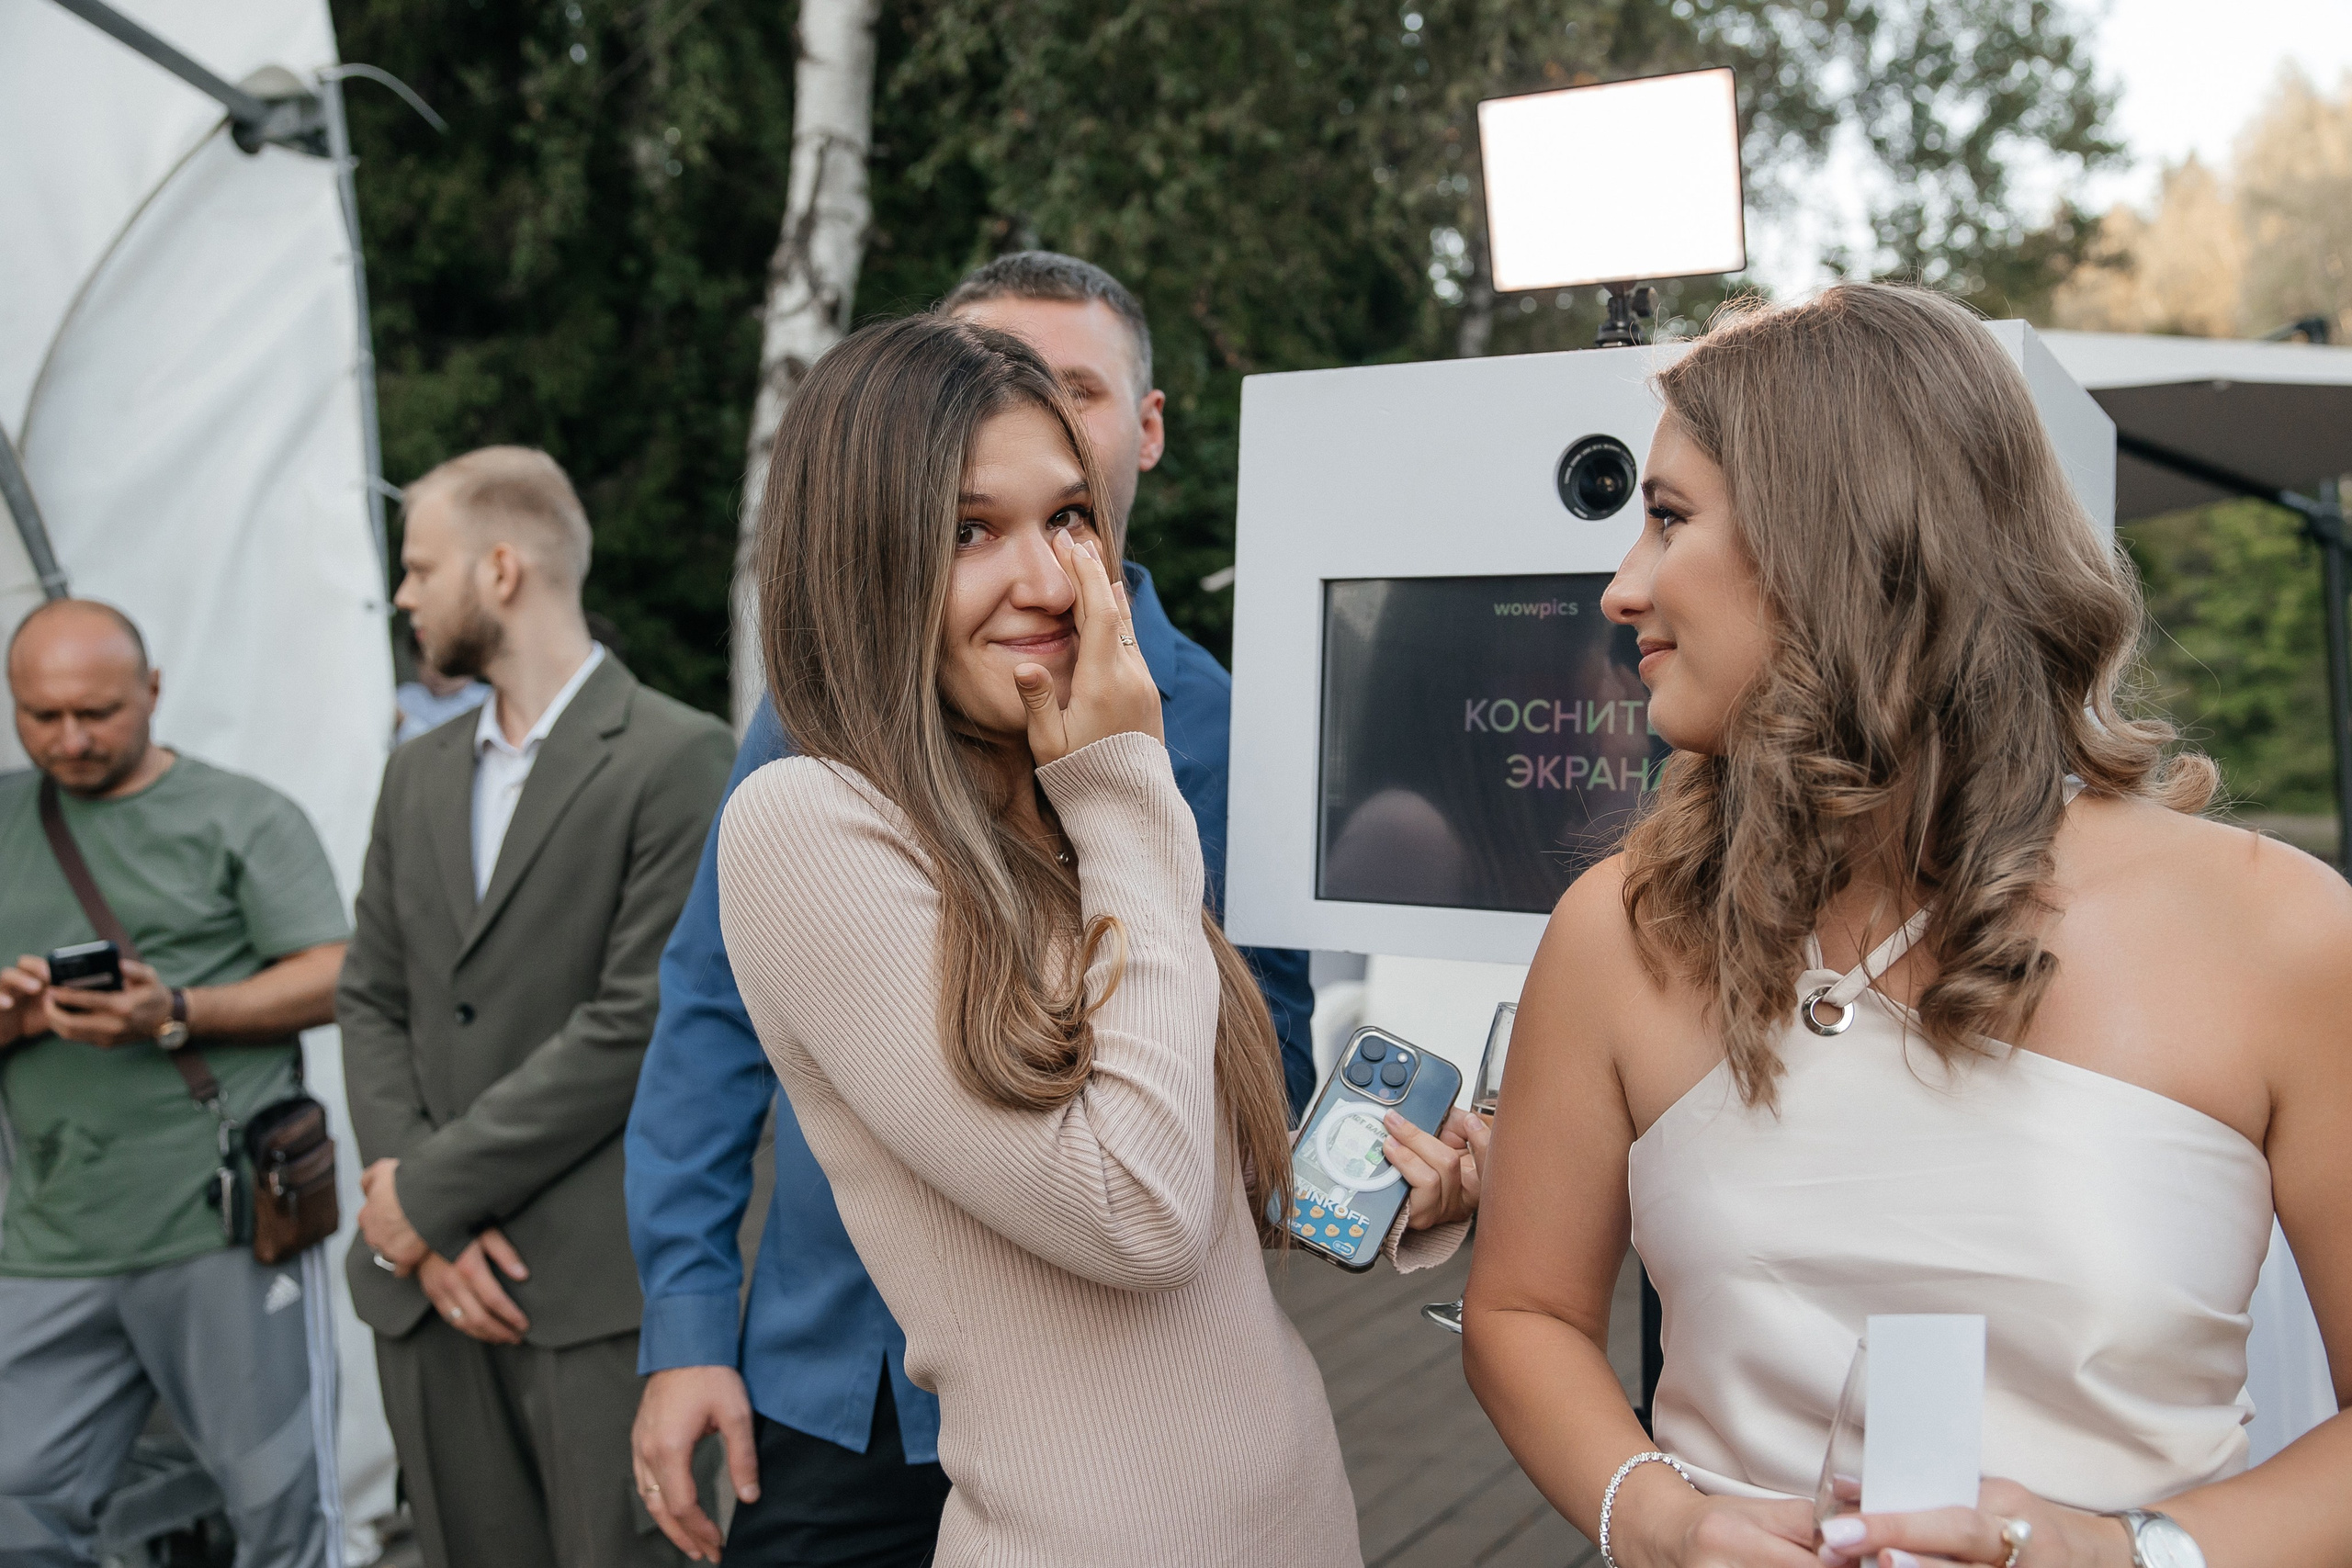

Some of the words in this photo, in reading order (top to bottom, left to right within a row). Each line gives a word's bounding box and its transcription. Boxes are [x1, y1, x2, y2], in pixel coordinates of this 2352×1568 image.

[1494, 598, 1578, 619] wowpics
[1464, 698, 1658, 736] КОСНИТ
[1295, 1184, 1370, 1225] TINKOFF
